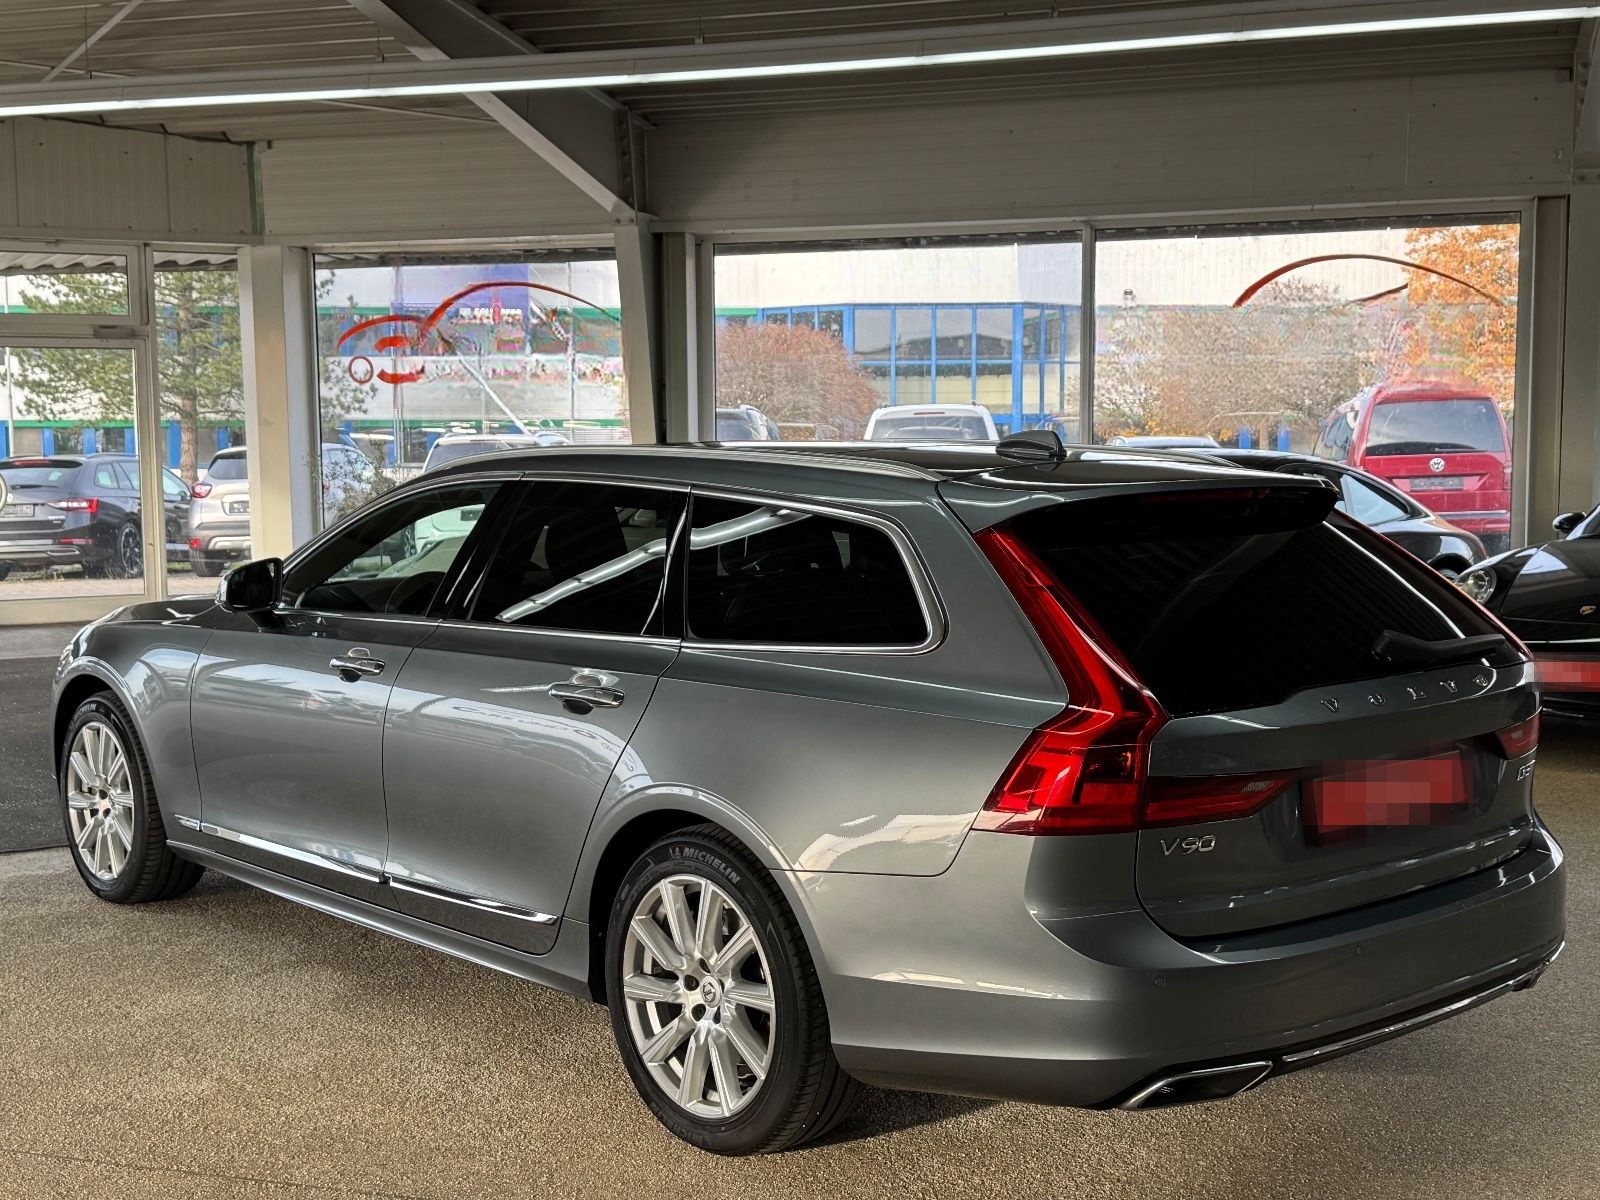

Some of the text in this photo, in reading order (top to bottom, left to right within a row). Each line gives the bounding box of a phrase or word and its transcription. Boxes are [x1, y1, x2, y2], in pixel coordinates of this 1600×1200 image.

[1320, 674, 1489, 713] VOLVO
[1160, 834, 1216, 856] V90
[683, 846, 741, 884] MICHELIN
